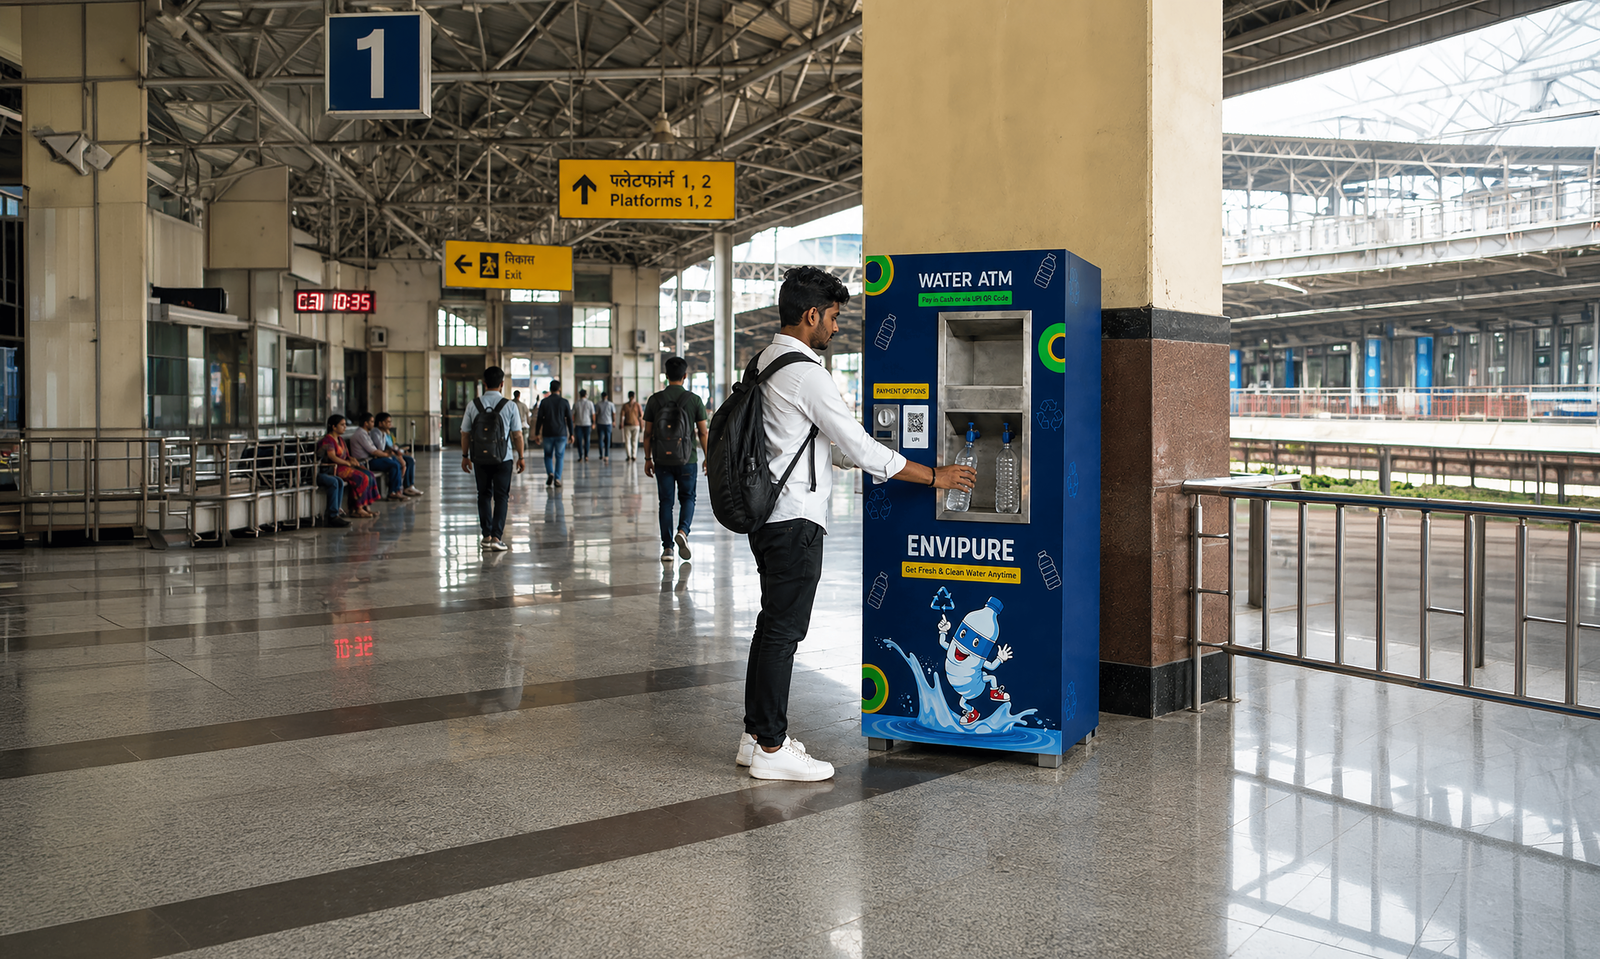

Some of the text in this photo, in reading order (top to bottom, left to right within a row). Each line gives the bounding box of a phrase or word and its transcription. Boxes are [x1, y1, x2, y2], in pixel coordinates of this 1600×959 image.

[356, 28, 384, 99] 1
[682, 174, 695, 191] 1,
[702, 174, 711, 189] 2
[610, 193, 713, 210] Platforms 1, 2
[504, 250, 535, 265] निकास
[505, 269, 522, 280] Exit
[918, 270, 1012, 288] WATER ATM
[332, 293, 371, 310] 10:35
[922, 296, 932, 304] Pay
[940, 295, 954, 303] Cash
[907, 534, 1014, 561] ENVIPURE
[905, 565, 917, 574] Get
[918, 566, 937, 575] Fresh
[945, 567, 965, 577] Clean
[965, 569, 986, 578] Water
[988, 570, 1017, 580] Anytime
